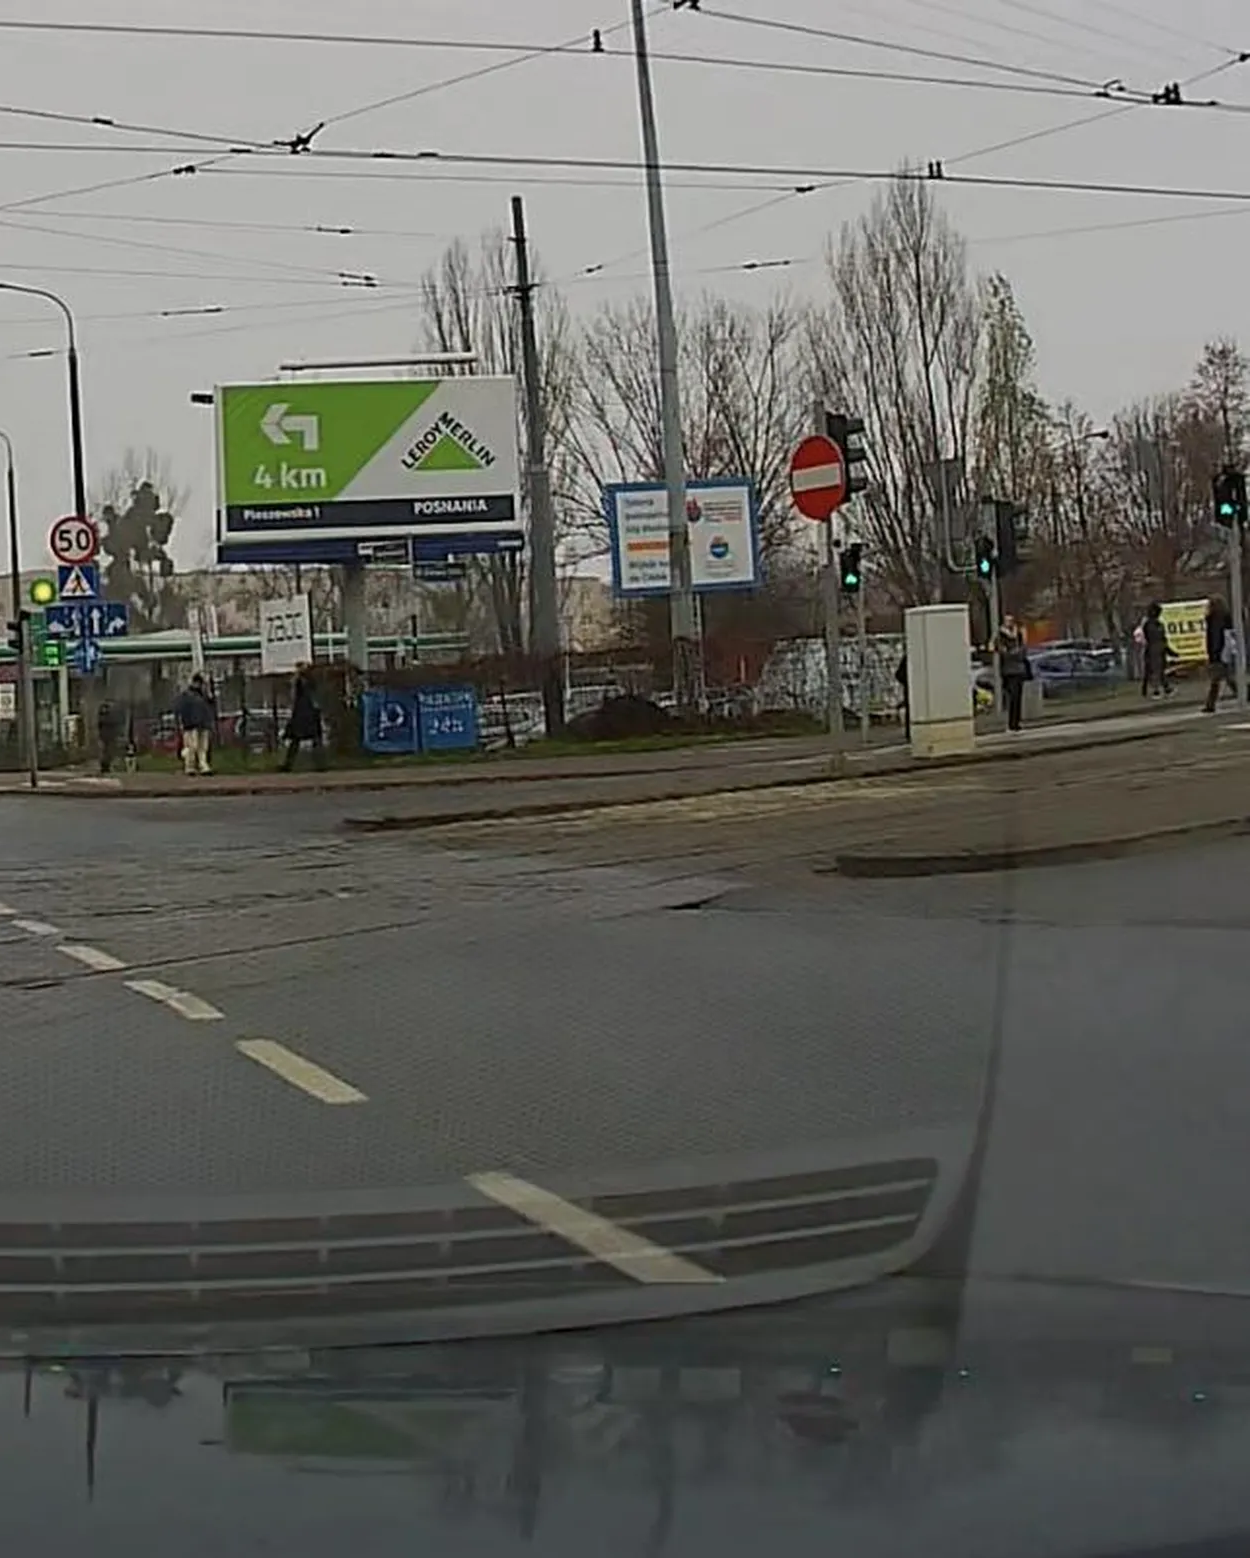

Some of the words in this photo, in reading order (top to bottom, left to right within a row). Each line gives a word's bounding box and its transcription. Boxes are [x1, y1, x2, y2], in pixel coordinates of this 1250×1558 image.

[401, 422, 443, 469] LEROY
[437, 411, 496, 467] MERLIN
[253, 463, 274, 489] 4
[280, 460, 327, 489] km
[413, 499, 488, 515] POSNANIA
[58, 529, 91, 552] 50
